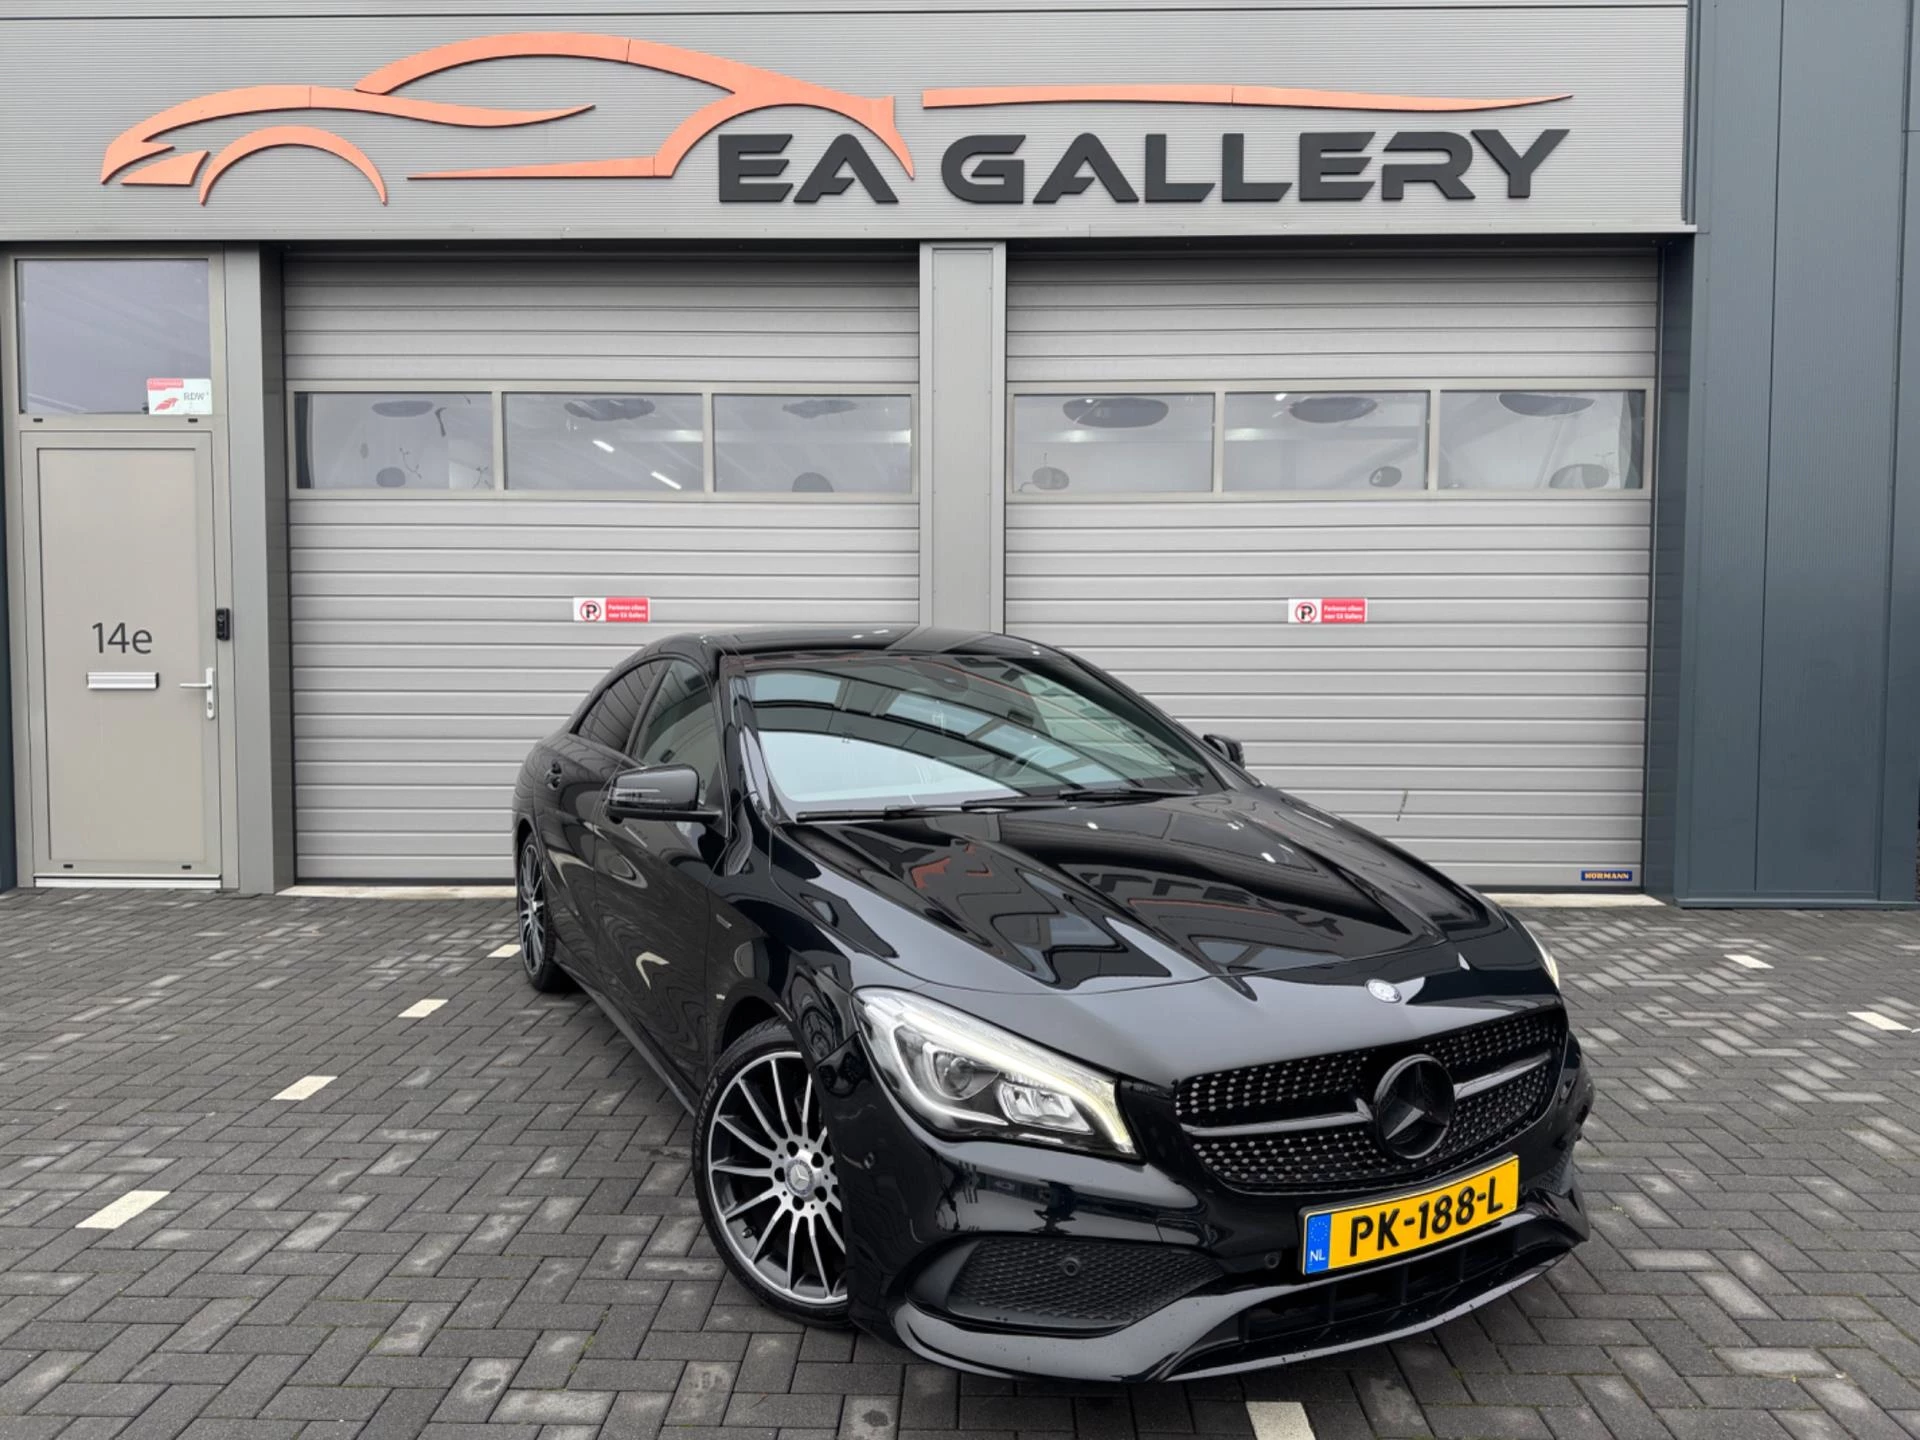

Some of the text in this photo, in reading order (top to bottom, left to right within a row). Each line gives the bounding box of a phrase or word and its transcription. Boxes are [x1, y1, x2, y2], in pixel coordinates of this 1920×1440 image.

[718, 128, 1571, 204] EA GALLERY
[92, 622, 153, 654] 14e
[1349, 1175, 1503, 1257] PK-188-L
[1310, 1249, 1327, 1262] NL
